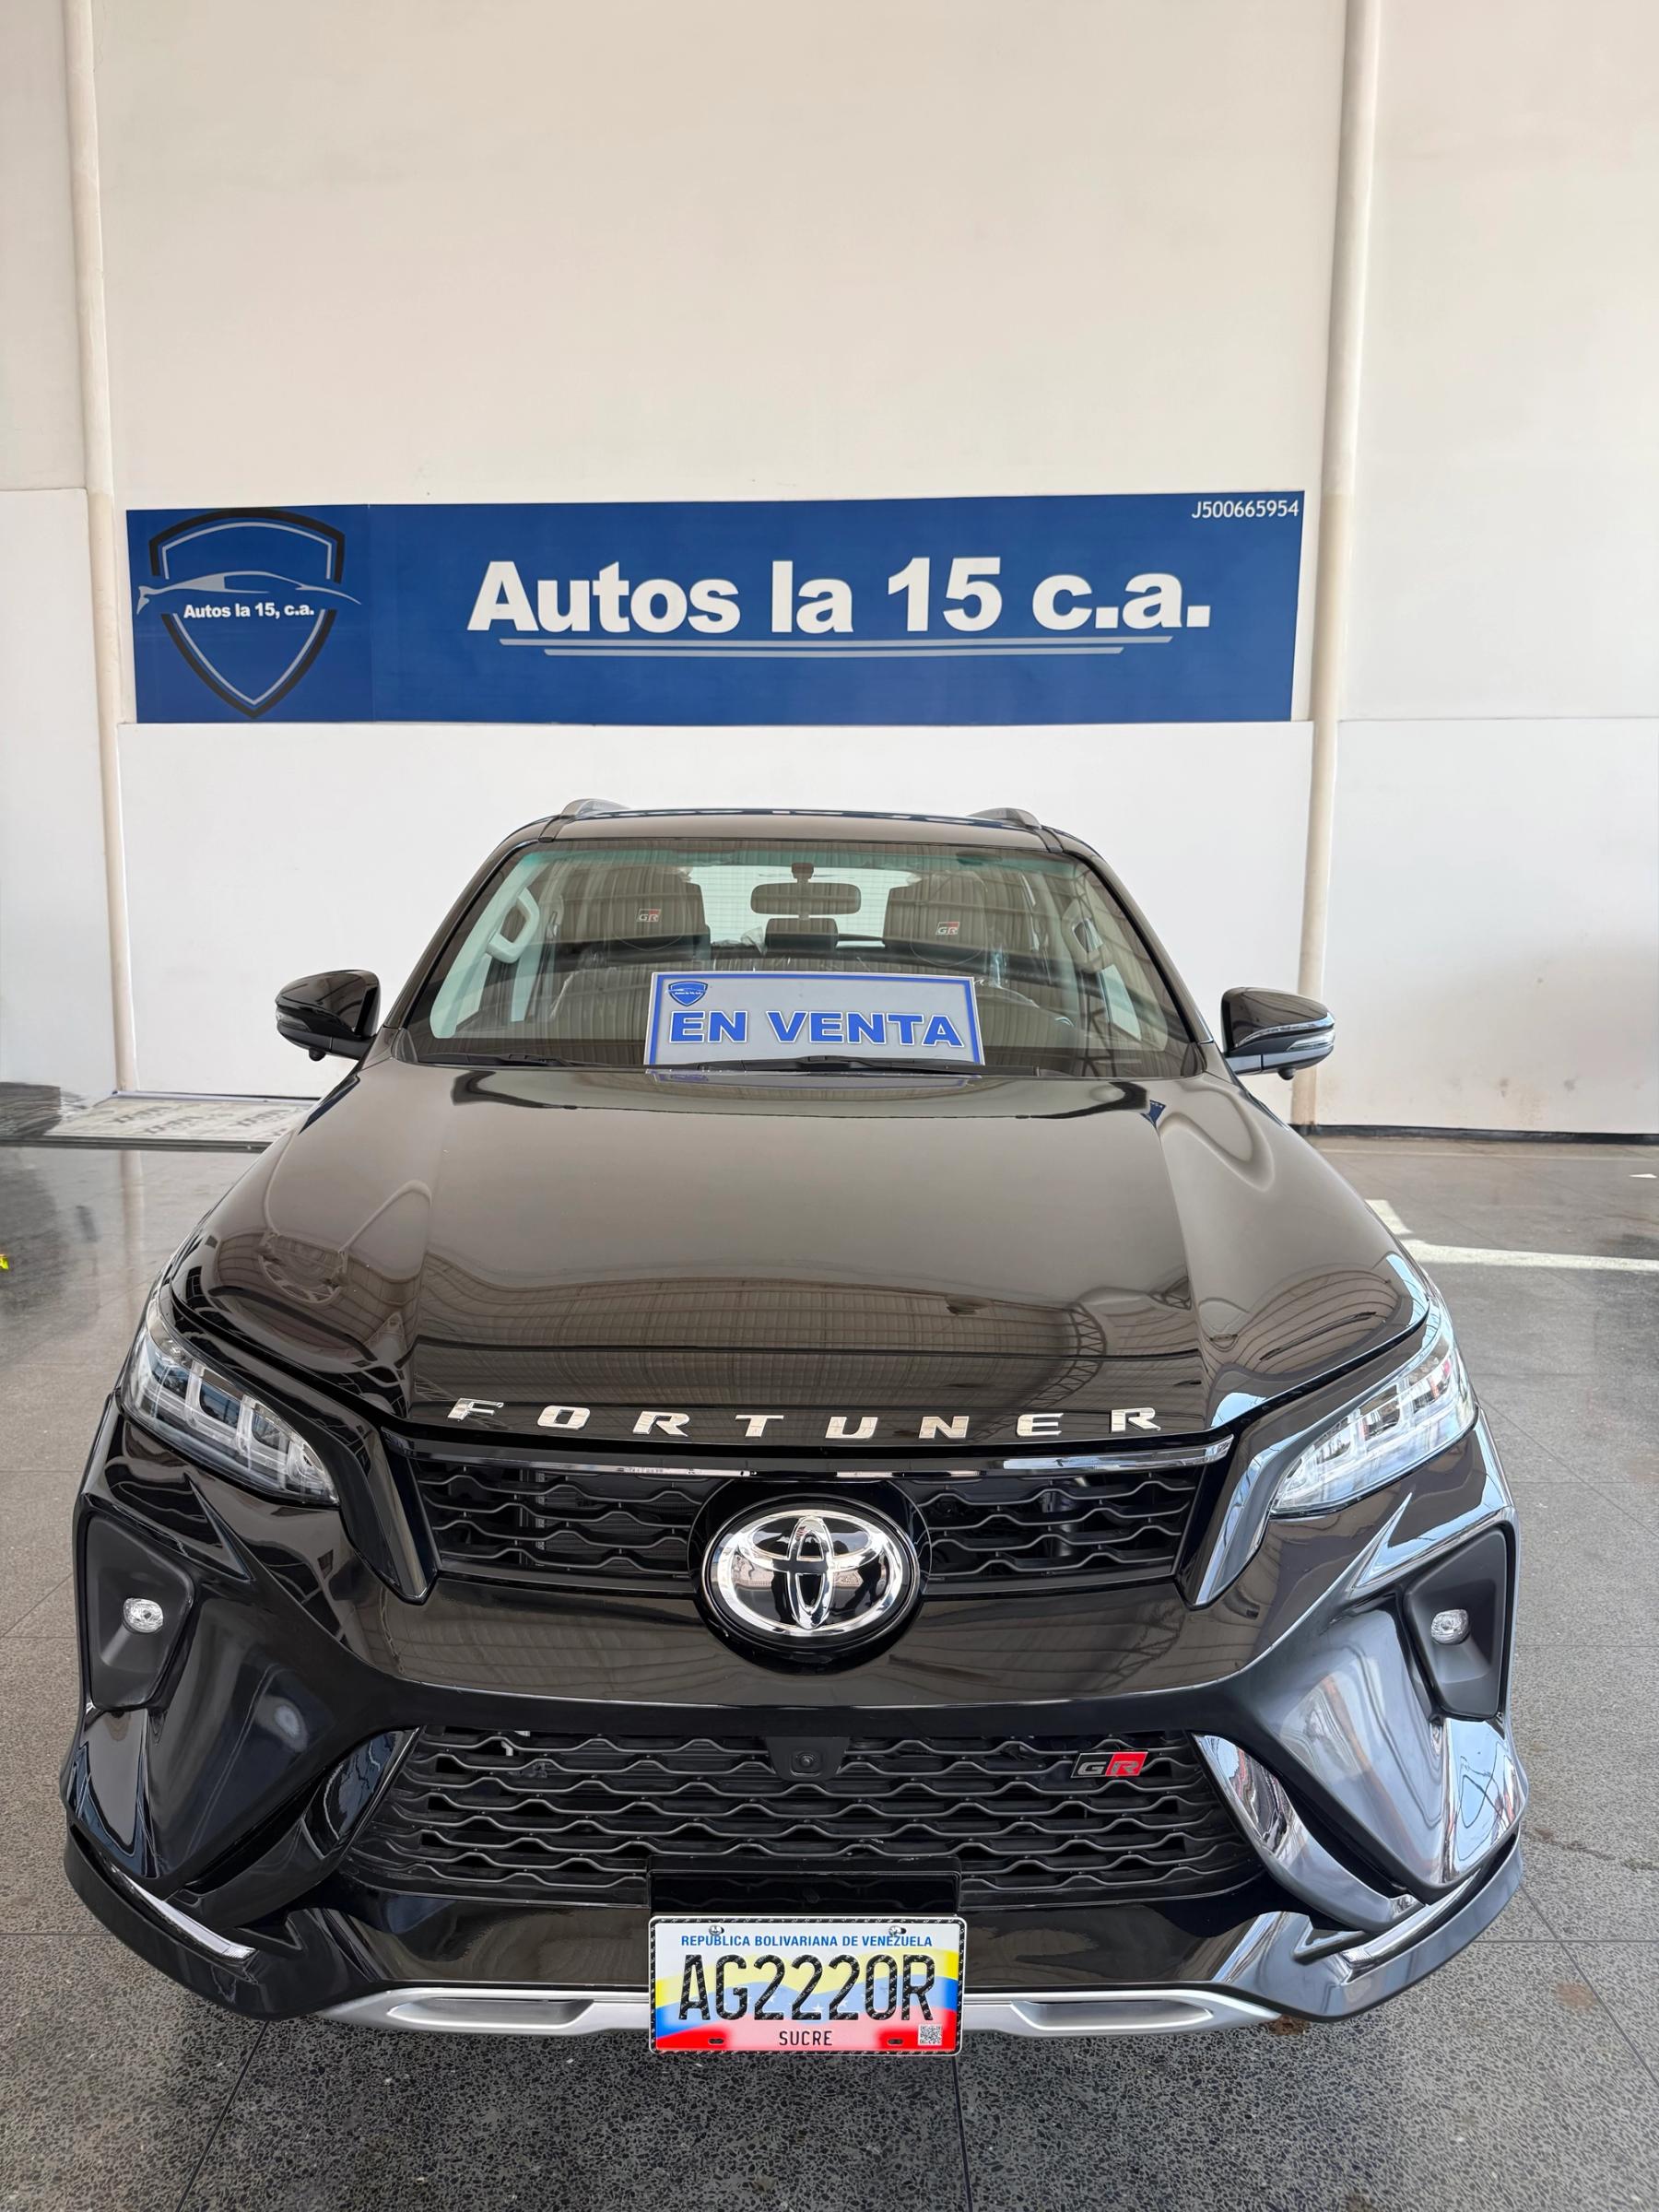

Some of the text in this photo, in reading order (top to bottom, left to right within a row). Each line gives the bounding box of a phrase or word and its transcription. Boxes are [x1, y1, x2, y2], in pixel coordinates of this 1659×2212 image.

[1192, 500, 1300, 519] J500665954
[467, 557, 1211, 634] Autos la 15 c.a.
[183, 601, 315, 620] Autos la 15, c.a.
[669, 1010, 966, 1049] EN VENTA
[446, 1396, 1163, 1441] FORTUNER
[755, 1935, 838, 1947] BOLIVARIANA
[842, 1935, 859, 1947] DE
[863, 1935, 933, 1947] VENEZUELA
[778, 2030, 833, 2047] SUCRE
